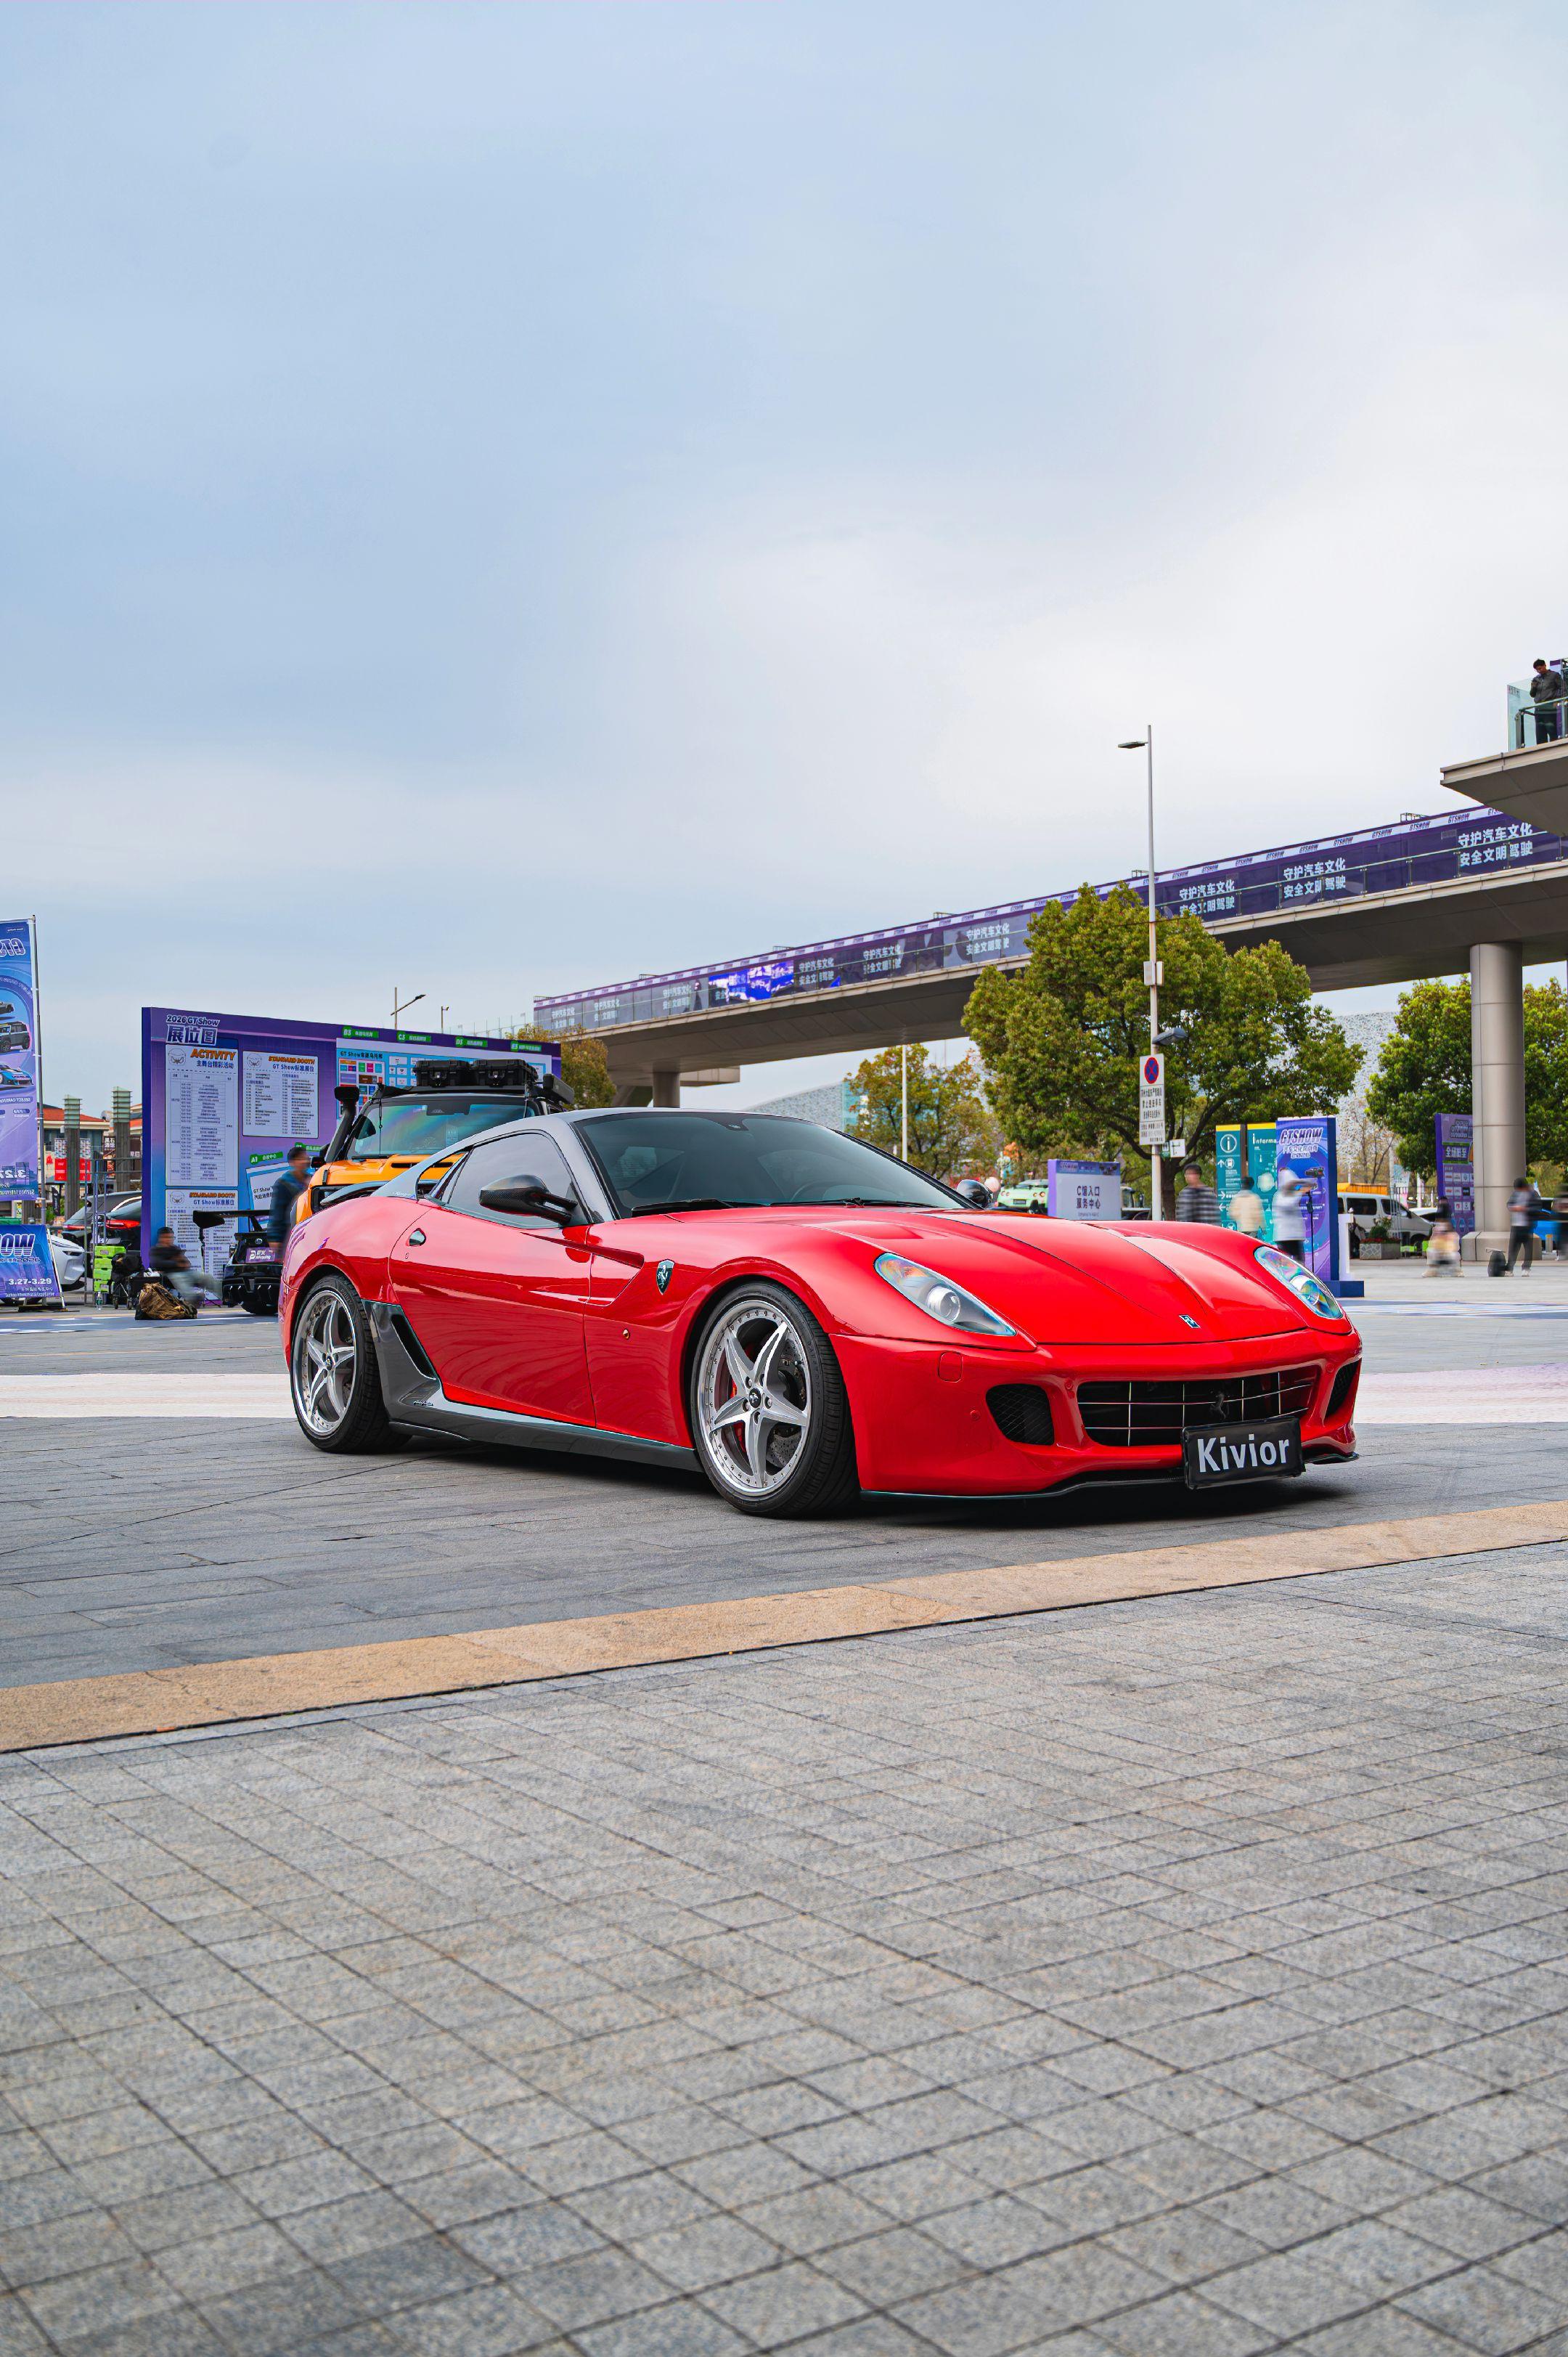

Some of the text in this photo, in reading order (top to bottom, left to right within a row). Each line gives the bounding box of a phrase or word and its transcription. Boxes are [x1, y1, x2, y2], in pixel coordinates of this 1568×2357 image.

[1447, 813, 1470, 824] GTSHOW
[1410, 821, 1431, 831] GTSHOW
[1372, 829, 1393, 839] GTSHOW
[1458, 822, 1533, 848] 守护汽车文化
[1334, 836, 1353, 847] GTSHOW
[1265, 850, 1284, 860] GTSHOW
[1299, 844, 1319, 854] GTSHOW
[1460, 840, 1533, 867] 安全文明驾驶
[1236, 858, 1253, 866] GTSHOW
[1283, 858, 1346, 881] 守护汽车文化
[1179, 879, 1234, 901] 守护汽车文化
[1283, 875, 1346, 898] 安全文明驾驶
[966, 922, 1010, 941] 守护汽车文化
[863, 945, 901, 961] 守护汽车文化
[166, 1014, 220, 1027] 2026 GT Show
[166, 1024, 218, 1046] 展位图
[190, 1049, 236, 1061] ACTIVITY
[1280, 1127, 1323, 1145] GTSHOW
[1077, 1186, 1100, 1197] C馆入口
[1077, 1197, 1101, 1209] 服务中心
[1197, 1433, 1290, 1473] Kivior
